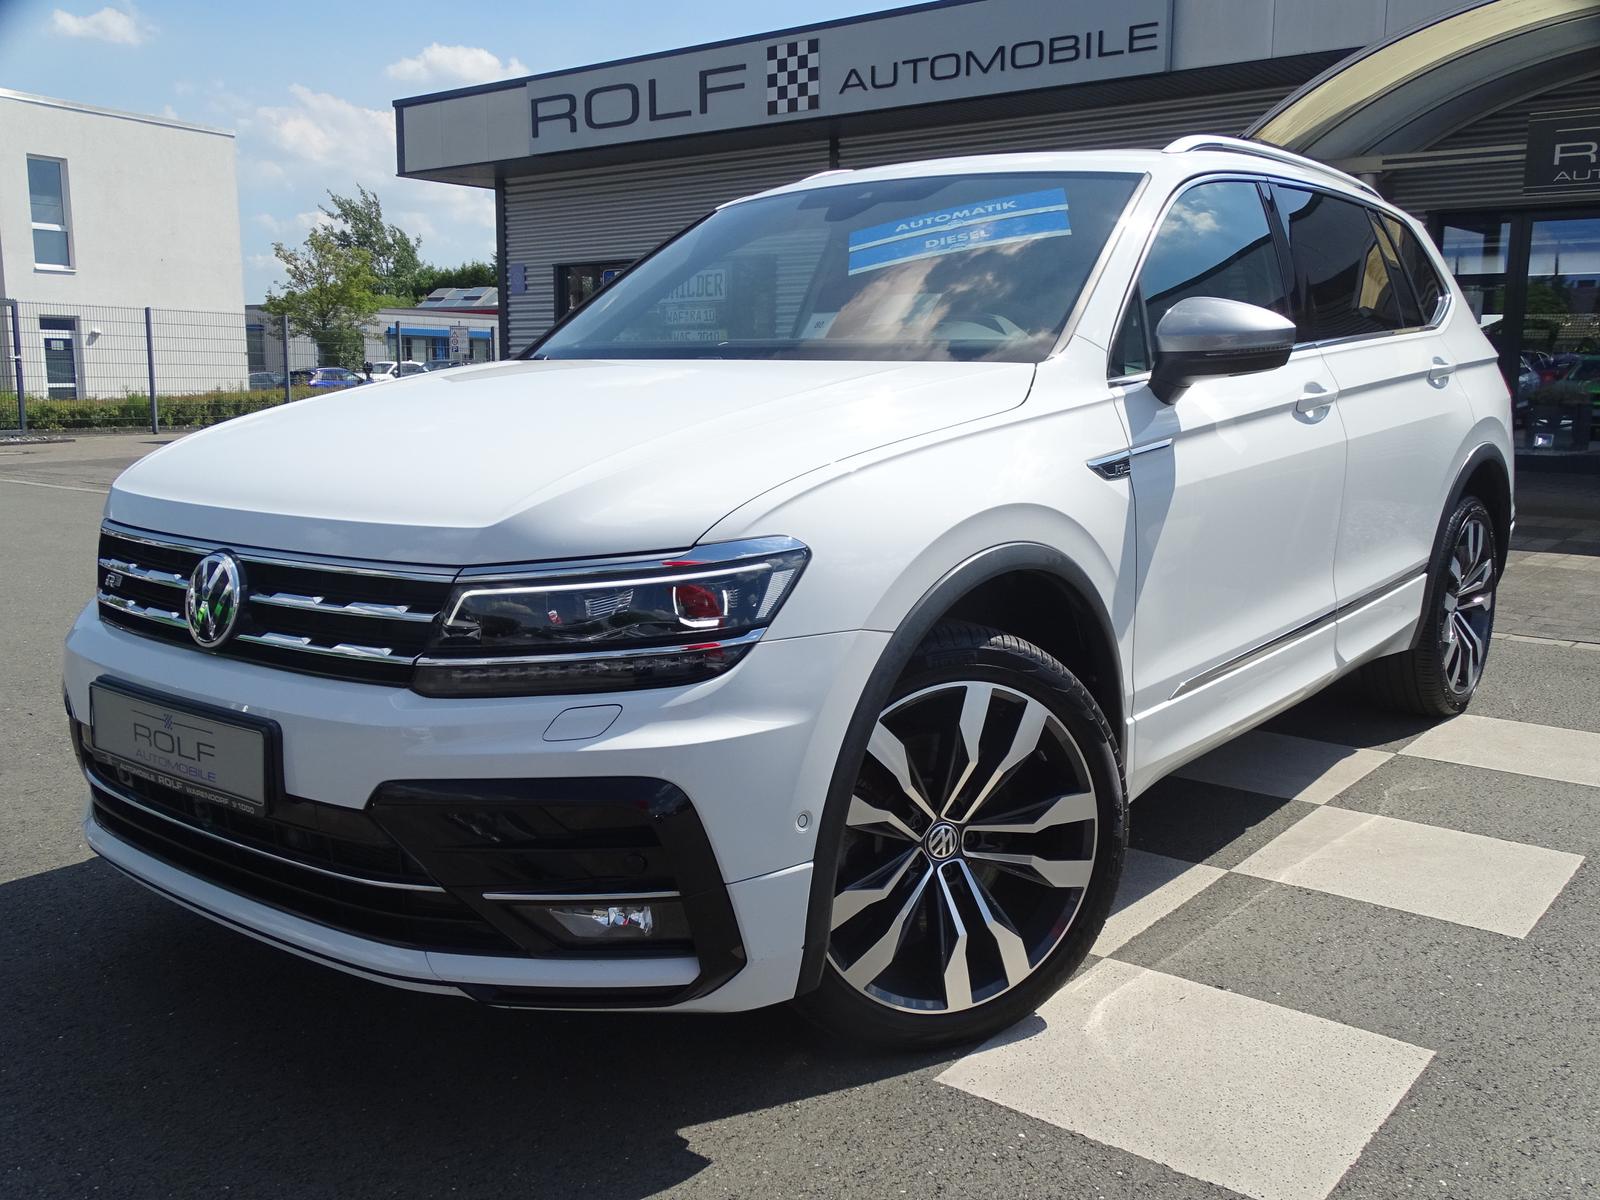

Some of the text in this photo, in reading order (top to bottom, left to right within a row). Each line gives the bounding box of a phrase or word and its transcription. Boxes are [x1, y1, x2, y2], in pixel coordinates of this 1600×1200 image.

[531, 22, 1159, 138] ROLF AUTOMOBILE
[895, 200, 1017, 232] AUTOMATIK
[925, 229, 990, 248] DIESEL
[133, 722, 216, 762] ROLF
[136, 749, 217, 784] AUTOMOBILE
[158, 775, 184, 790] ROLF
[186, 784, 229, 805] WARENDORF
